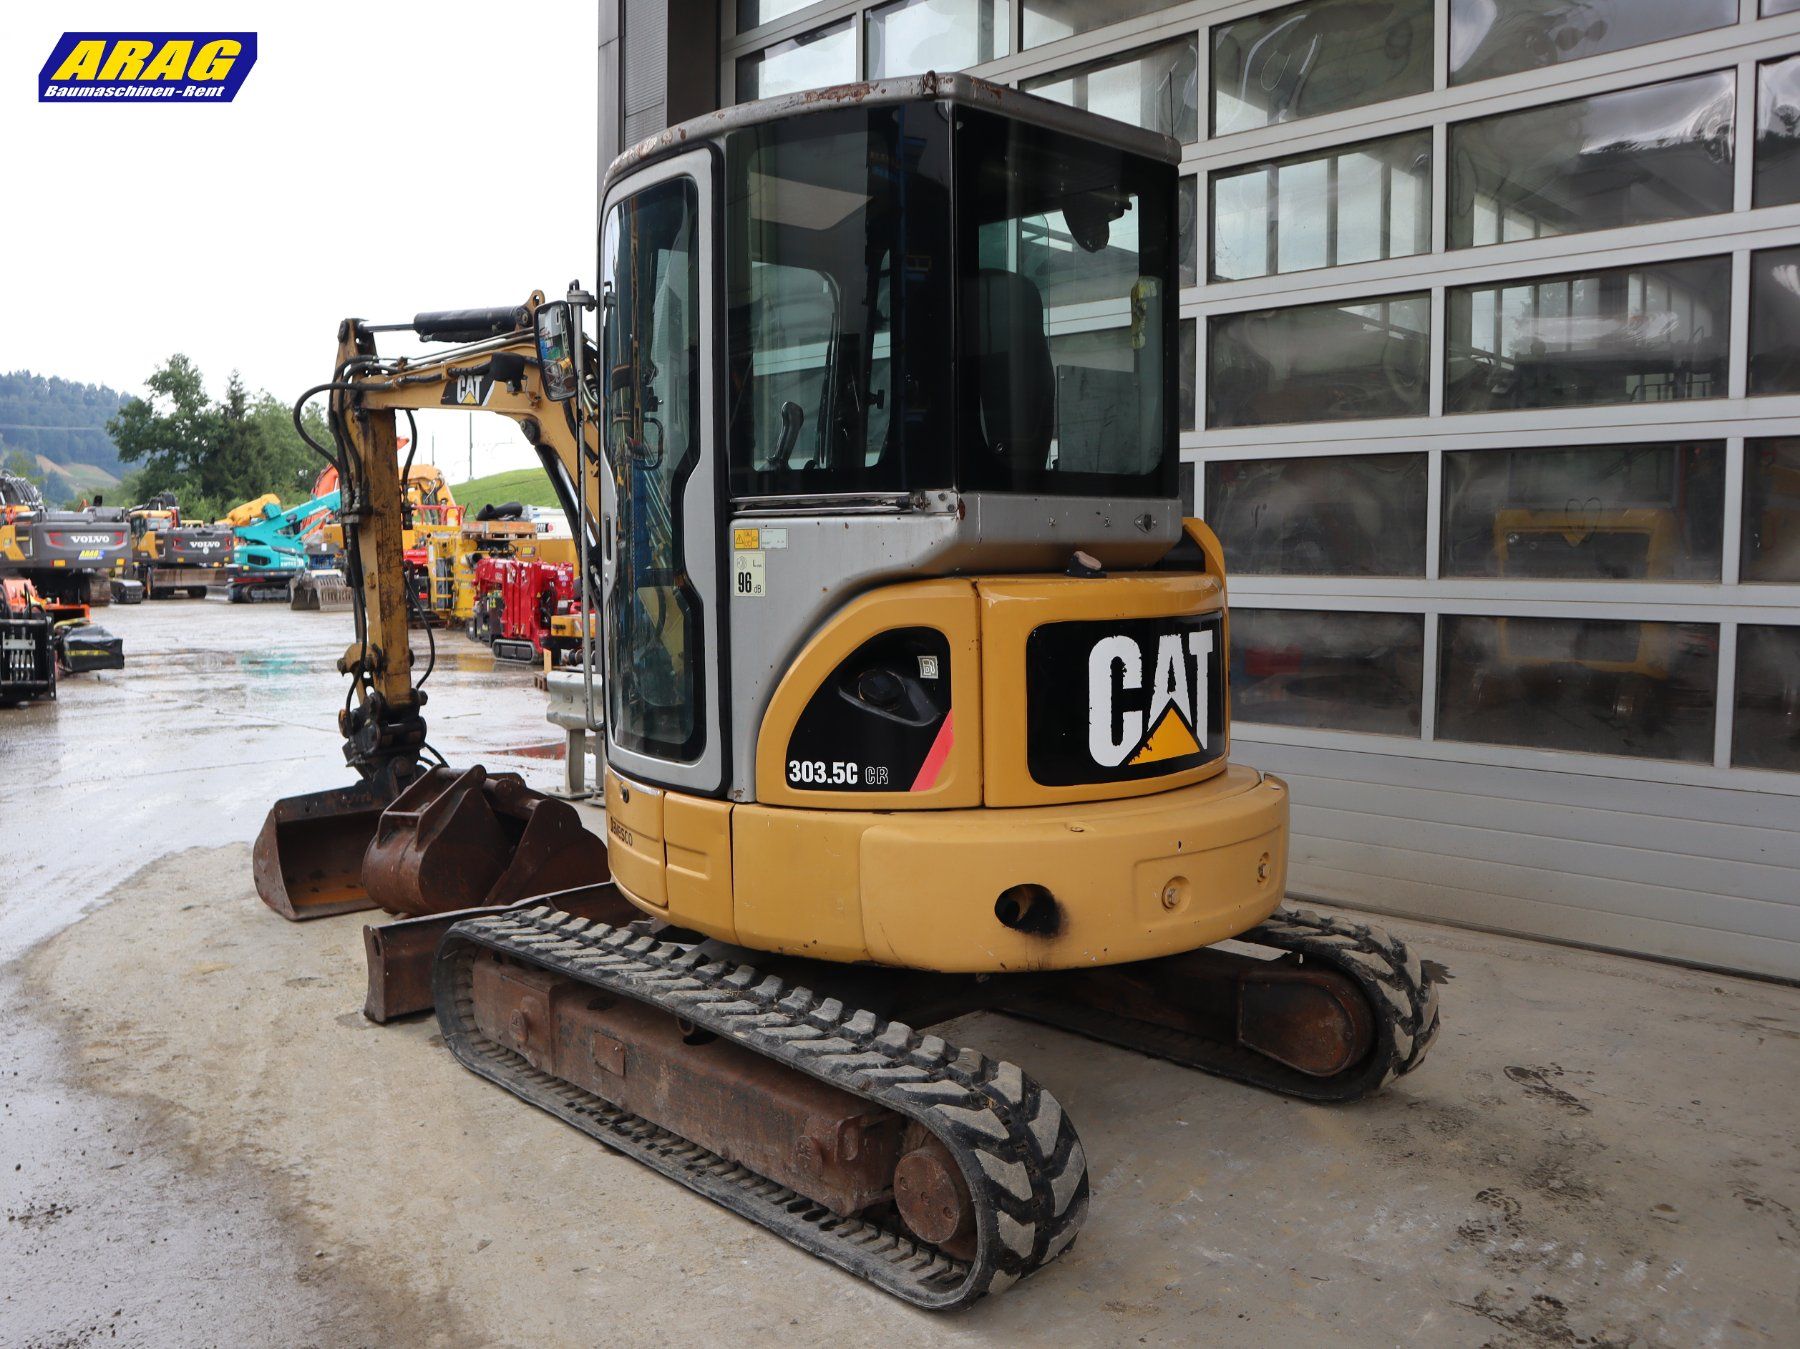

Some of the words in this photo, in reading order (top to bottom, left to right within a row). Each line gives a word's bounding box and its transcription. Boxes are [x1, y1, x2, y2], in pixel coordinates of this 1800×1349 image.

[456, 375, 484, 404] CAT
[71, 535, 110, 544] VOLVO
[738, 571, 752, 593] 96
[753, 585, 761, 593] dB
[1088, 629, 1214, 767] CAT
[789, 759, 858, 785] 303.5C
[865, 766, 889, 785] CR
